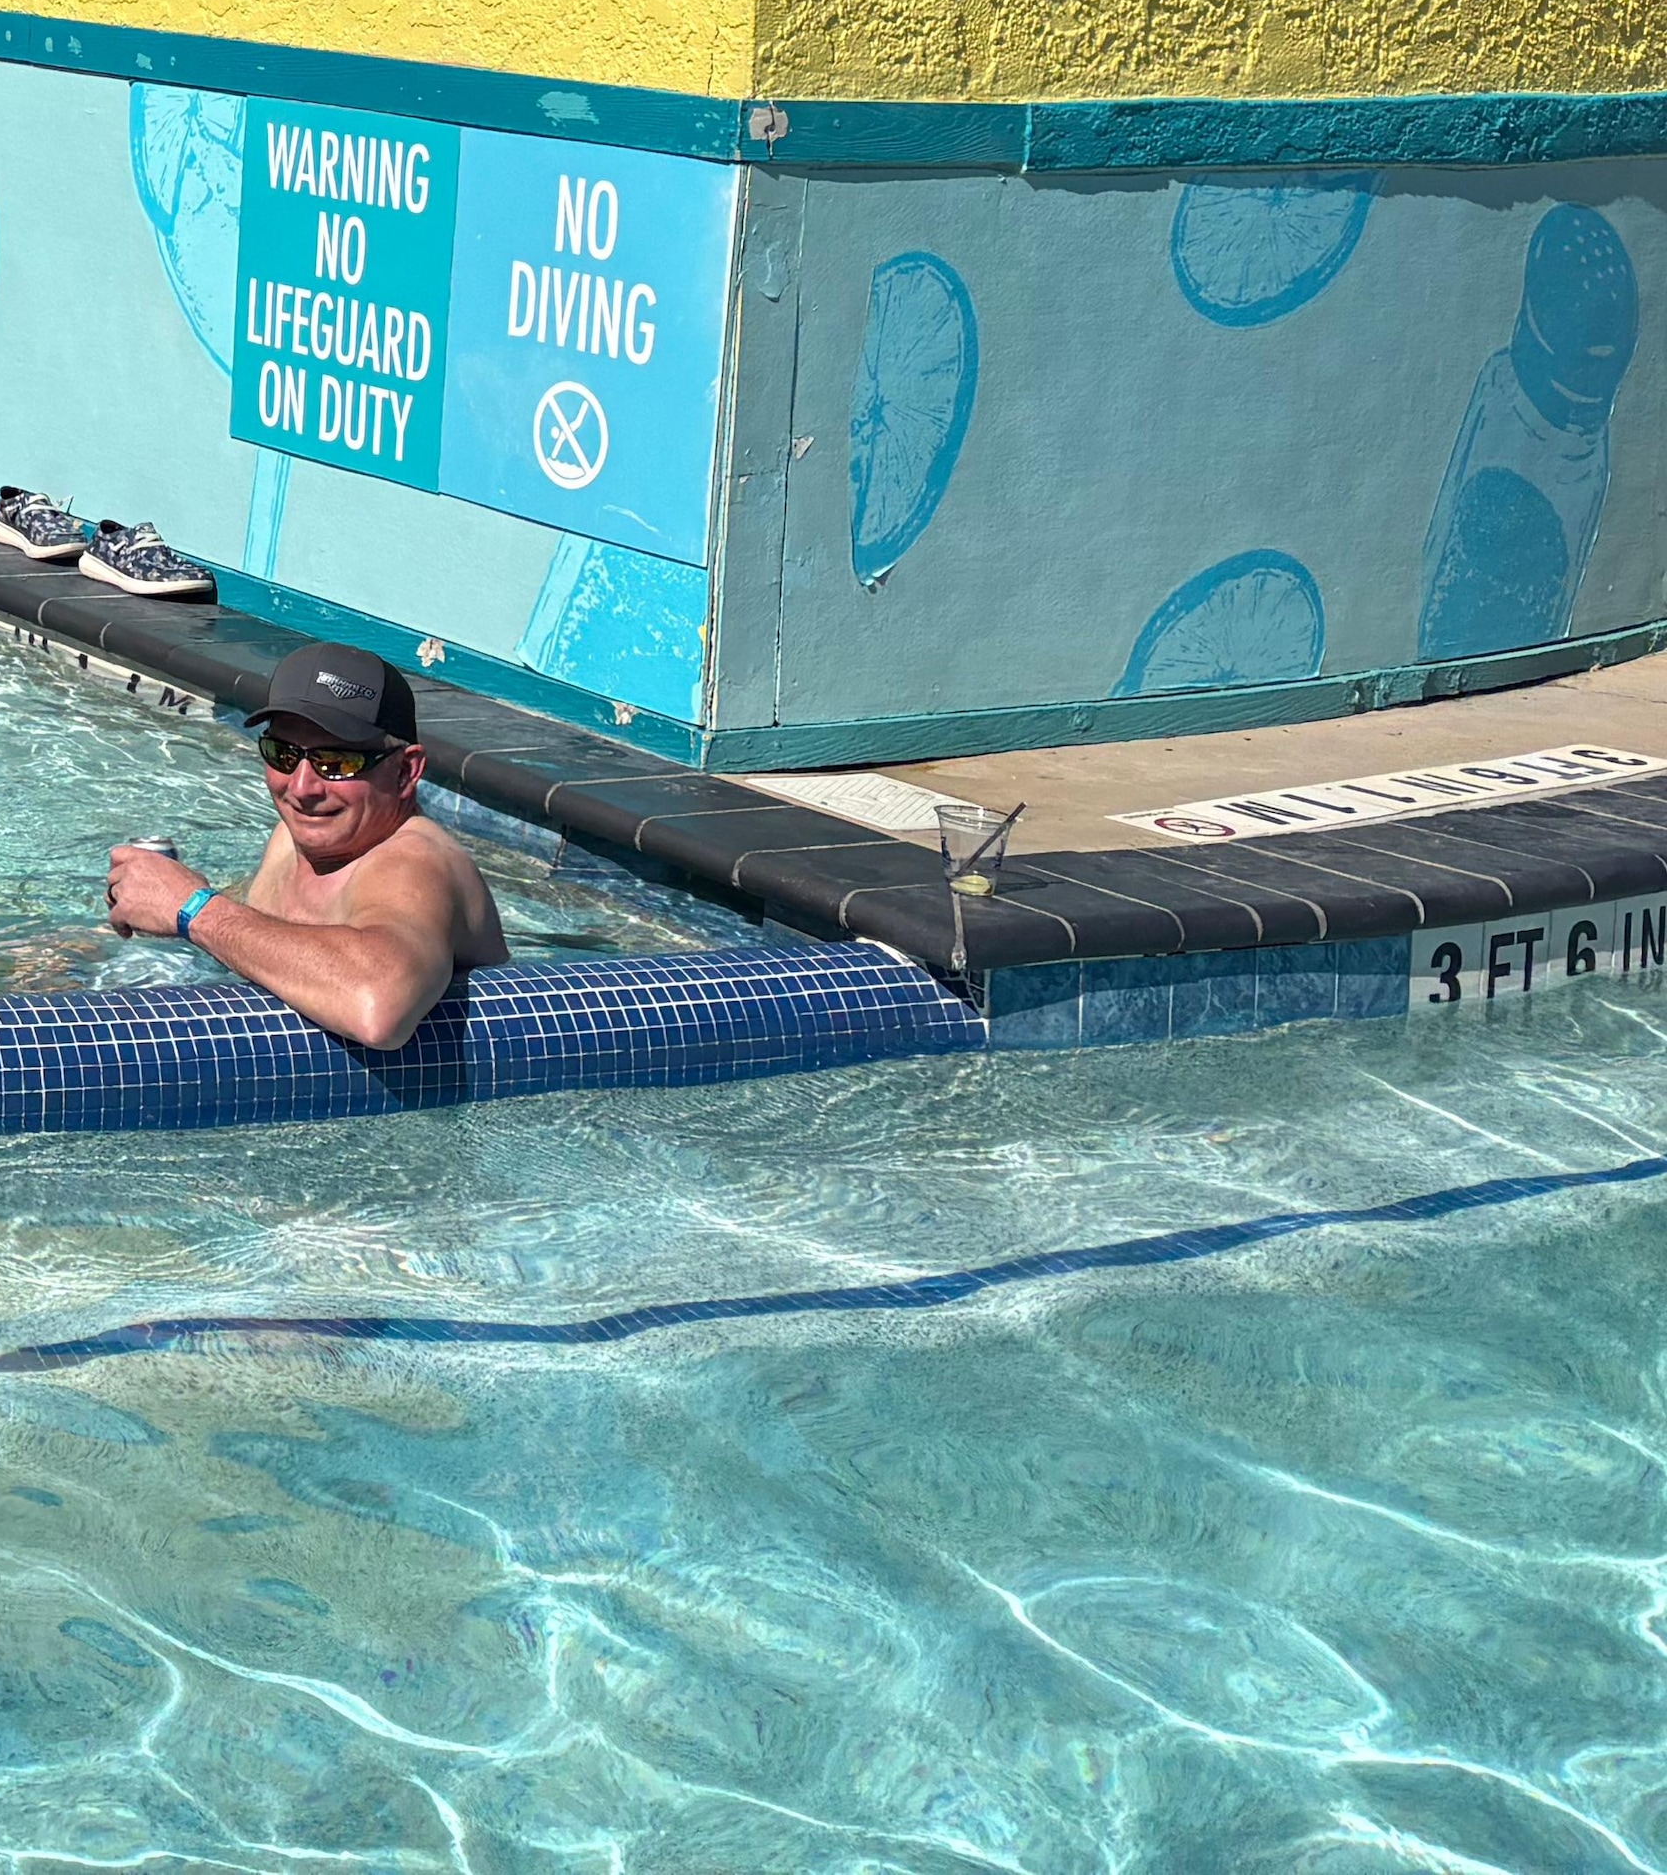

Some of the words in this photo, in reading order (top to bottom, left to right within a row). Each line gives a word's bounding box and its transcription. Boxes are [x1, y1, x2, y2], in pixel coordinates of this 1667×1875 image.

[267, 122, 430, 214] WARNING
[314, 210, 366, 285] NO
[554, 174, 619, 261] NO
[247, 277, 432, 382] LIFEGUARD
[507, 260, 657, 366] DIVING
[258, 360, 307, 435] ON
[318, 375, 413, 462] DUTY
[1213, 798, 1301, 826] M
[1429, 941, 1463, 1004] 3
[1487, 927, 1545, 1000] FT
[1566, 920, 1598, 977] 6
[1623, 905, 1667, 972] IN
